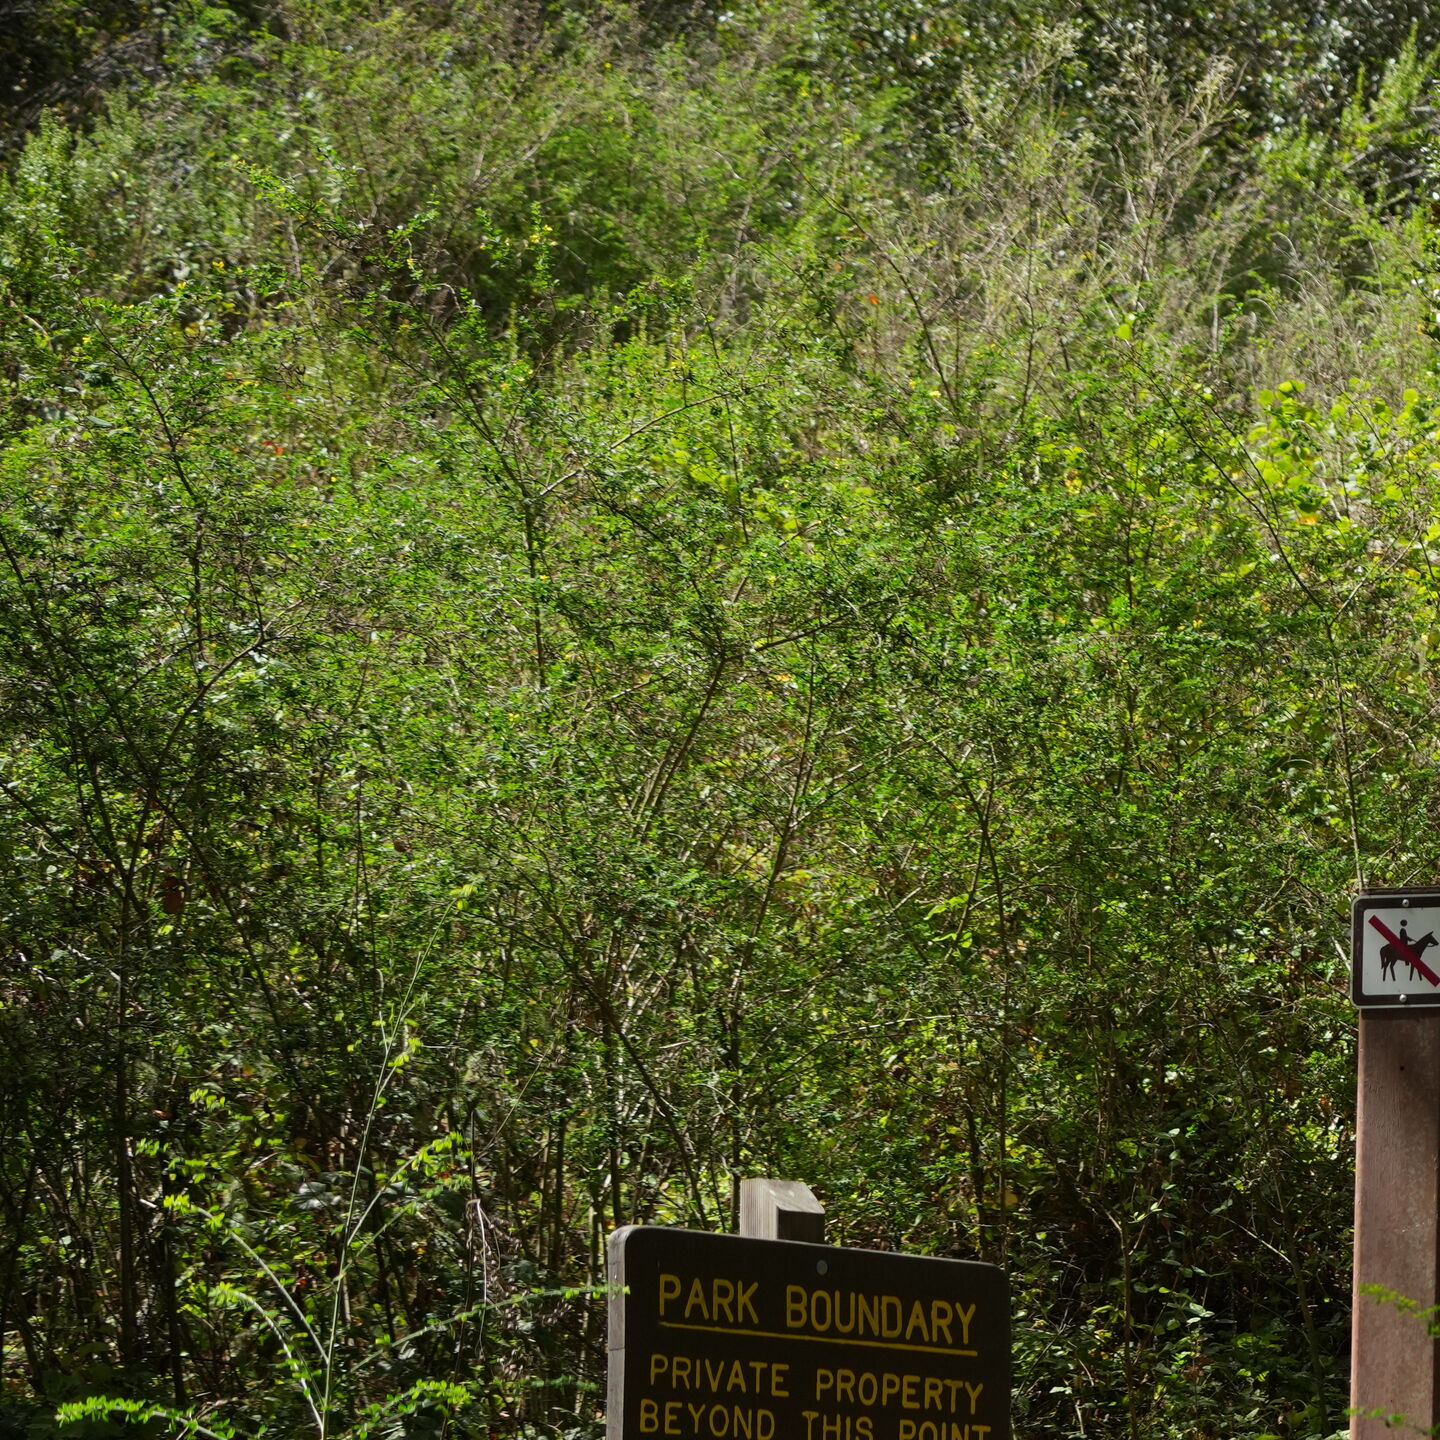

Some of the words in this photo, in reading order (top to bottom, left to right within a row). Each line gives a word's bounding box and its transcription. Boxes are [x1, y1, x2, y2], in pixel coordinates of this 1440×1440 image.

[659, 1273, 759, 1325] PARK
[785, 1284, 977, 1345] BOUNDARY
[650, 1353, 790, 1398] PRIVATE
[815, 1368, 983, 1415] PROPERTY
